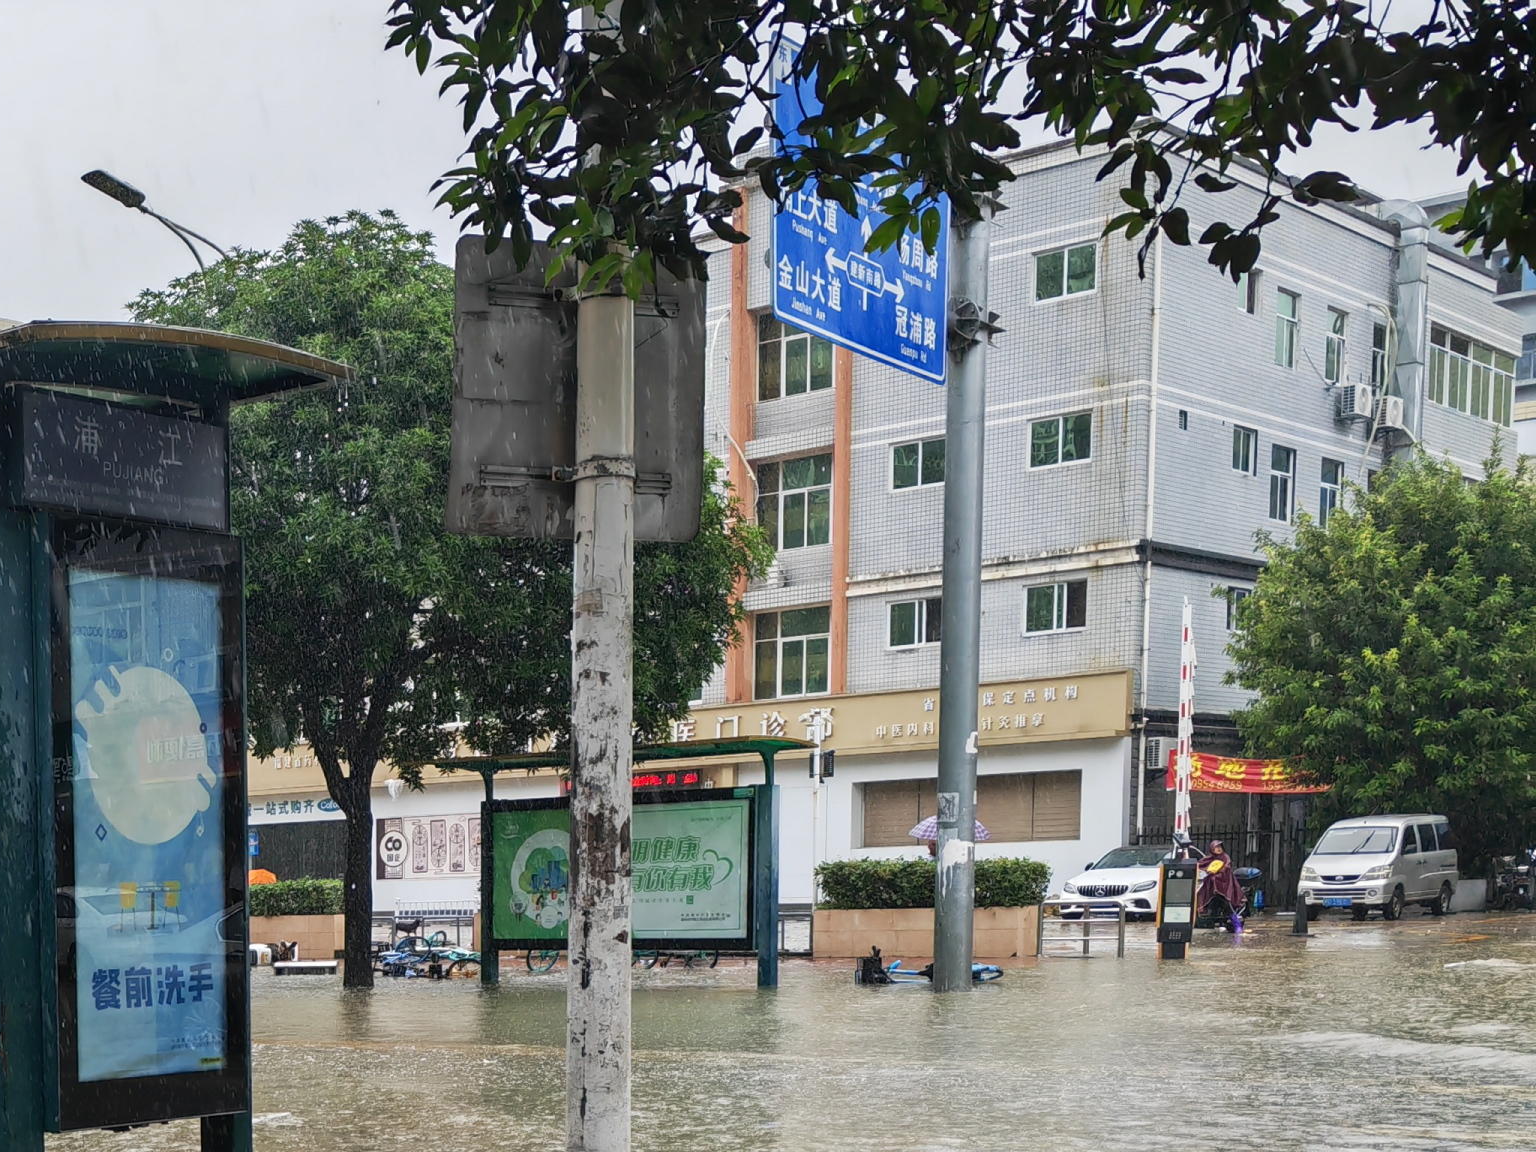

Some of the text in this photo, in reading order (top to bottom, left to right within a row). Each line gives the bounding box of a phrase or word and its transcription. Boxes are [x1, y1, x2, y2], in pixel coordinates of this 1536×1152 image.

[778, 254, 842, 312] 金山大道
[895, 304, 937, 351] 冠浦路
[103, 460, 164, 485] PUJIANG
[91, 962, 214, 1011] 餐前洗手
